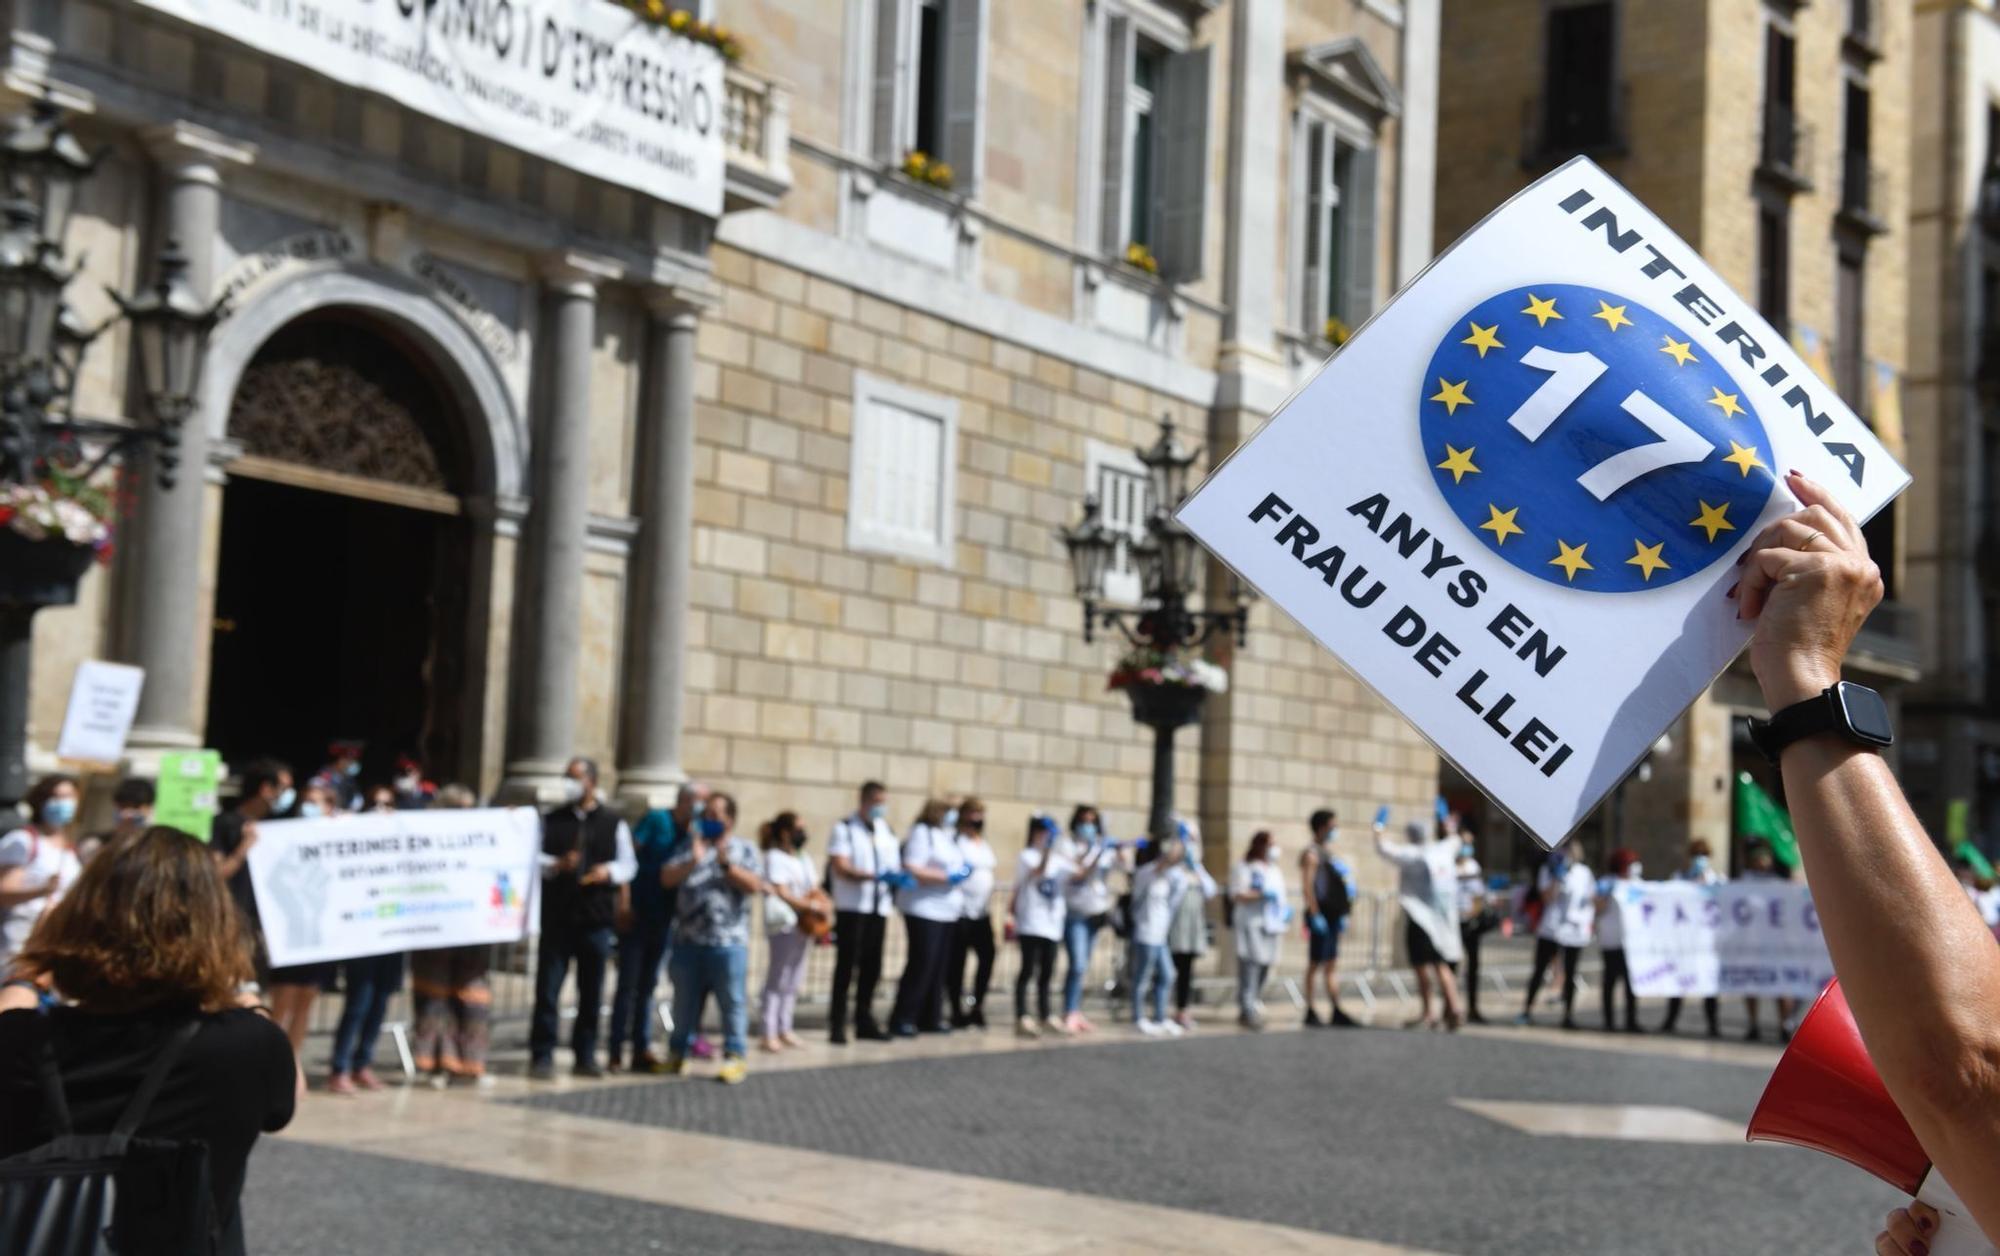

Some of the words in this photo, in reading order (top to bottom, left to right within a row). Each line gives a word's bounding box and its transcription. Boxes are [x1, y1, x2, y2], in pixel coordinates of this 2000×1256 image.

[1507, 344, 1716, 502] 17
[1557, 187, 1867, 488] INTERINA
[1248, 492, 1387, 609] FRAU
[1382, 605, 1461, 679] DE
[1455, 669, 1574, 778] LLEI
[1346, 492, 1488, 608] ANYS
[1486, 603, 1568, 678] EN
